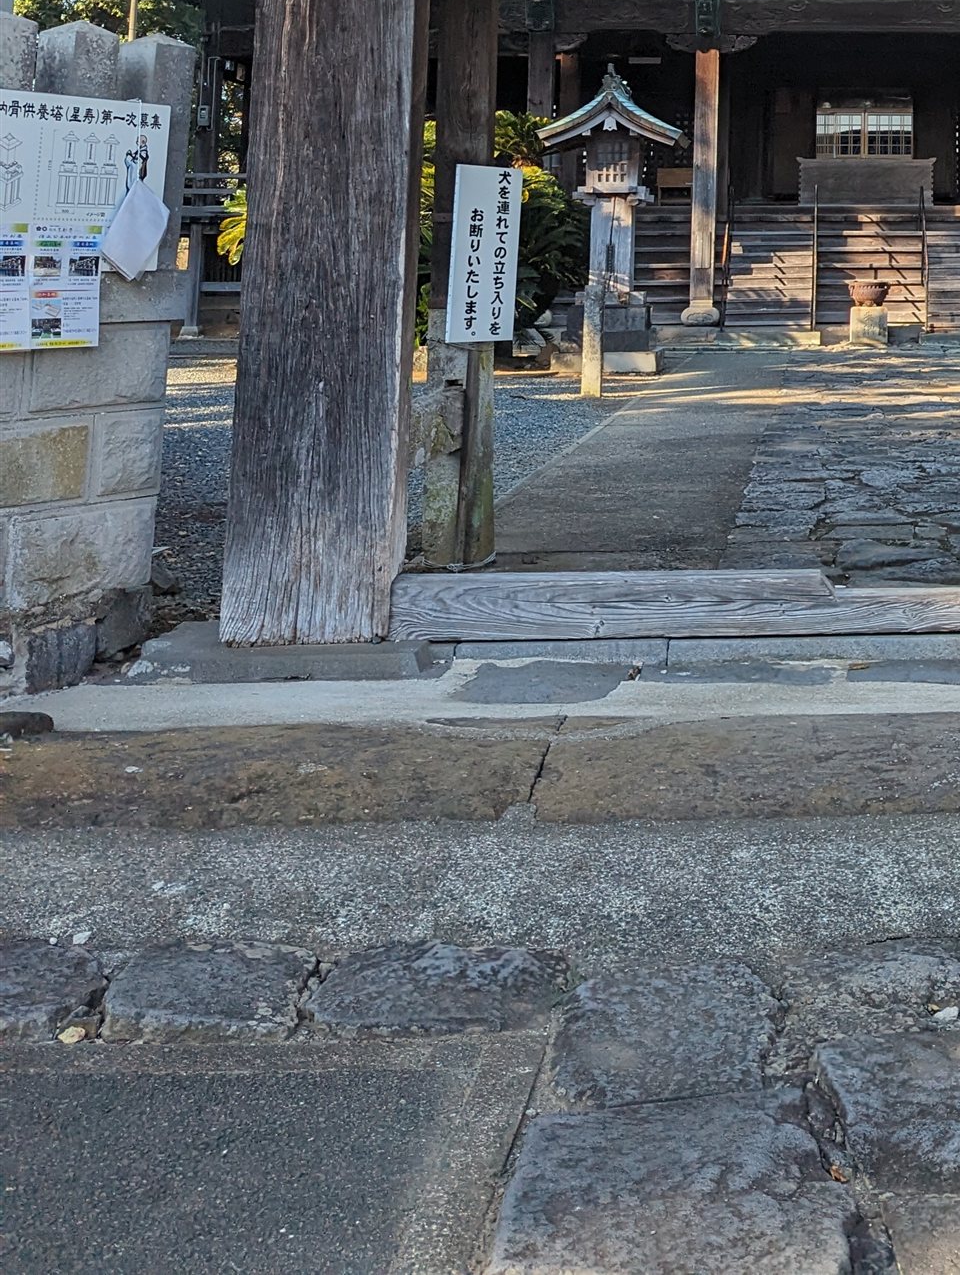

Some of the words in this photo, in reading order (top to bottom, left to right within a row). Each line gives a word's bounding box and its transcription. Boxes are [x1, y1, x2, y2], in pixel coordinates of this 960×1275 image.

[463, 207, 485, 337] お断りいたします。
[488, 170, 512, 336] 犬を連れての立ち入りを
